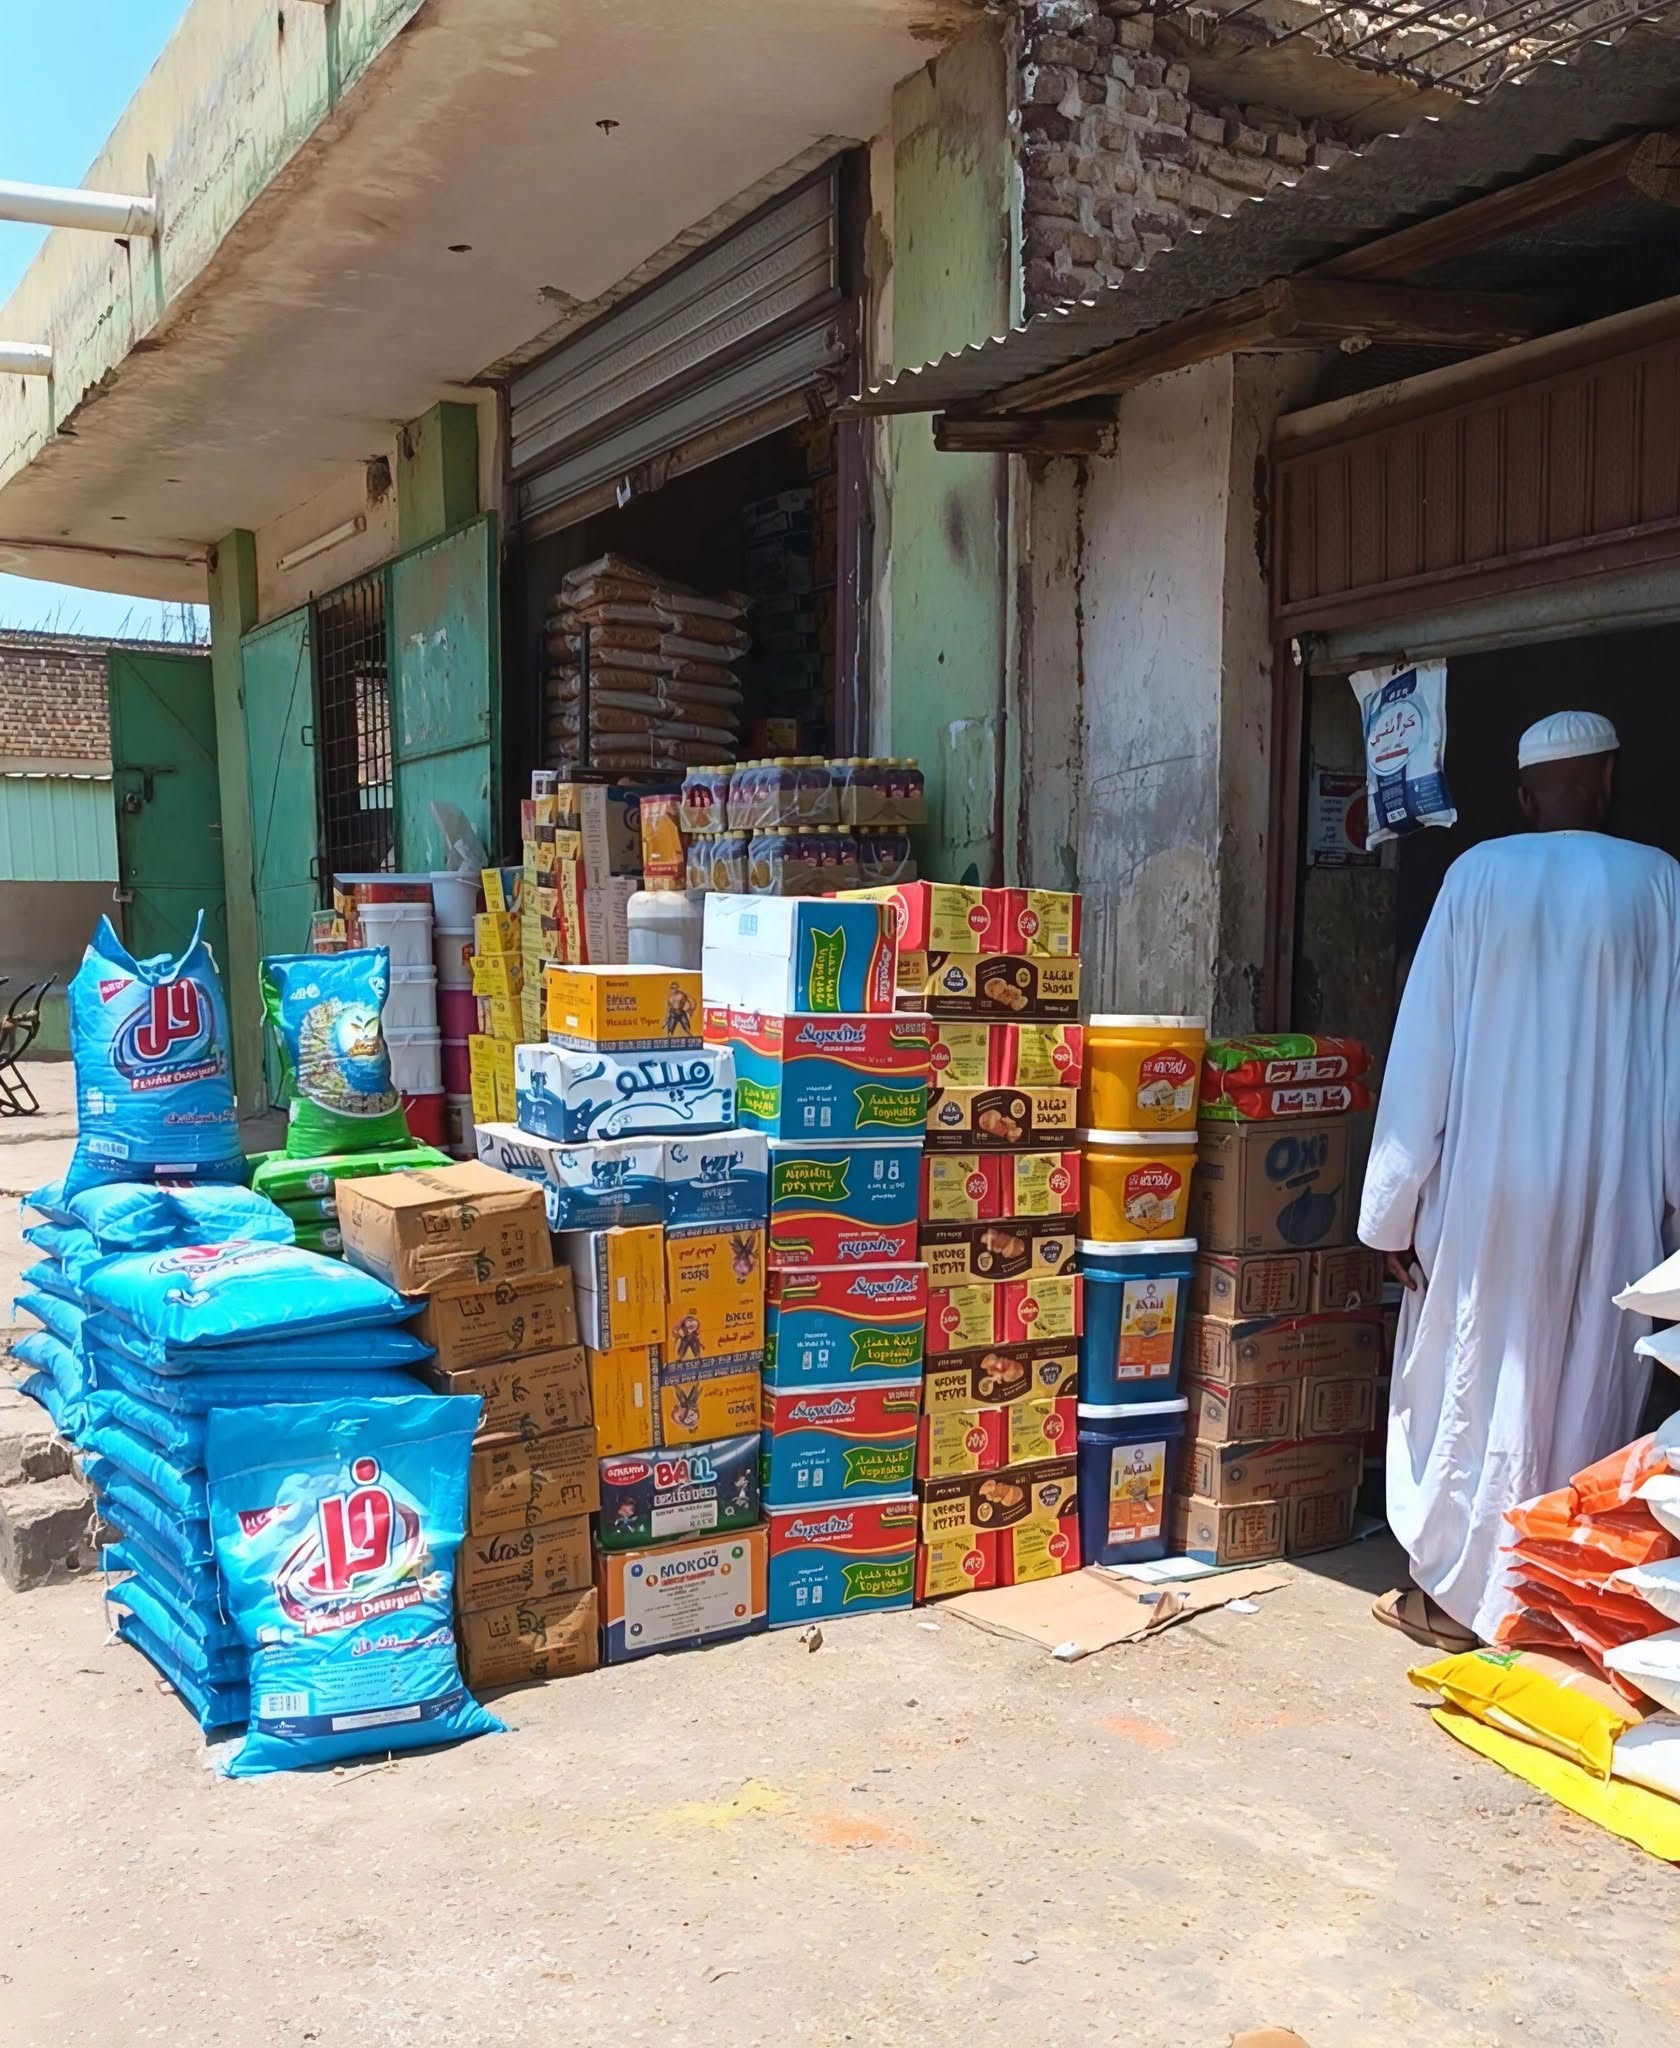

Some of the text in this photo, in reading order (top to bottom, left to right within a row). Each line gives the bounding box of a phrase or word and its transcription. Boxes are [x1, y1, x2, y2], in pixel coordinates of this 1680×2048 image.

[616, 1060, 713, 1102] ميلكو
[654, 1457, 718, 1490] BALL
[307, 1456, 395, 1592] فل
